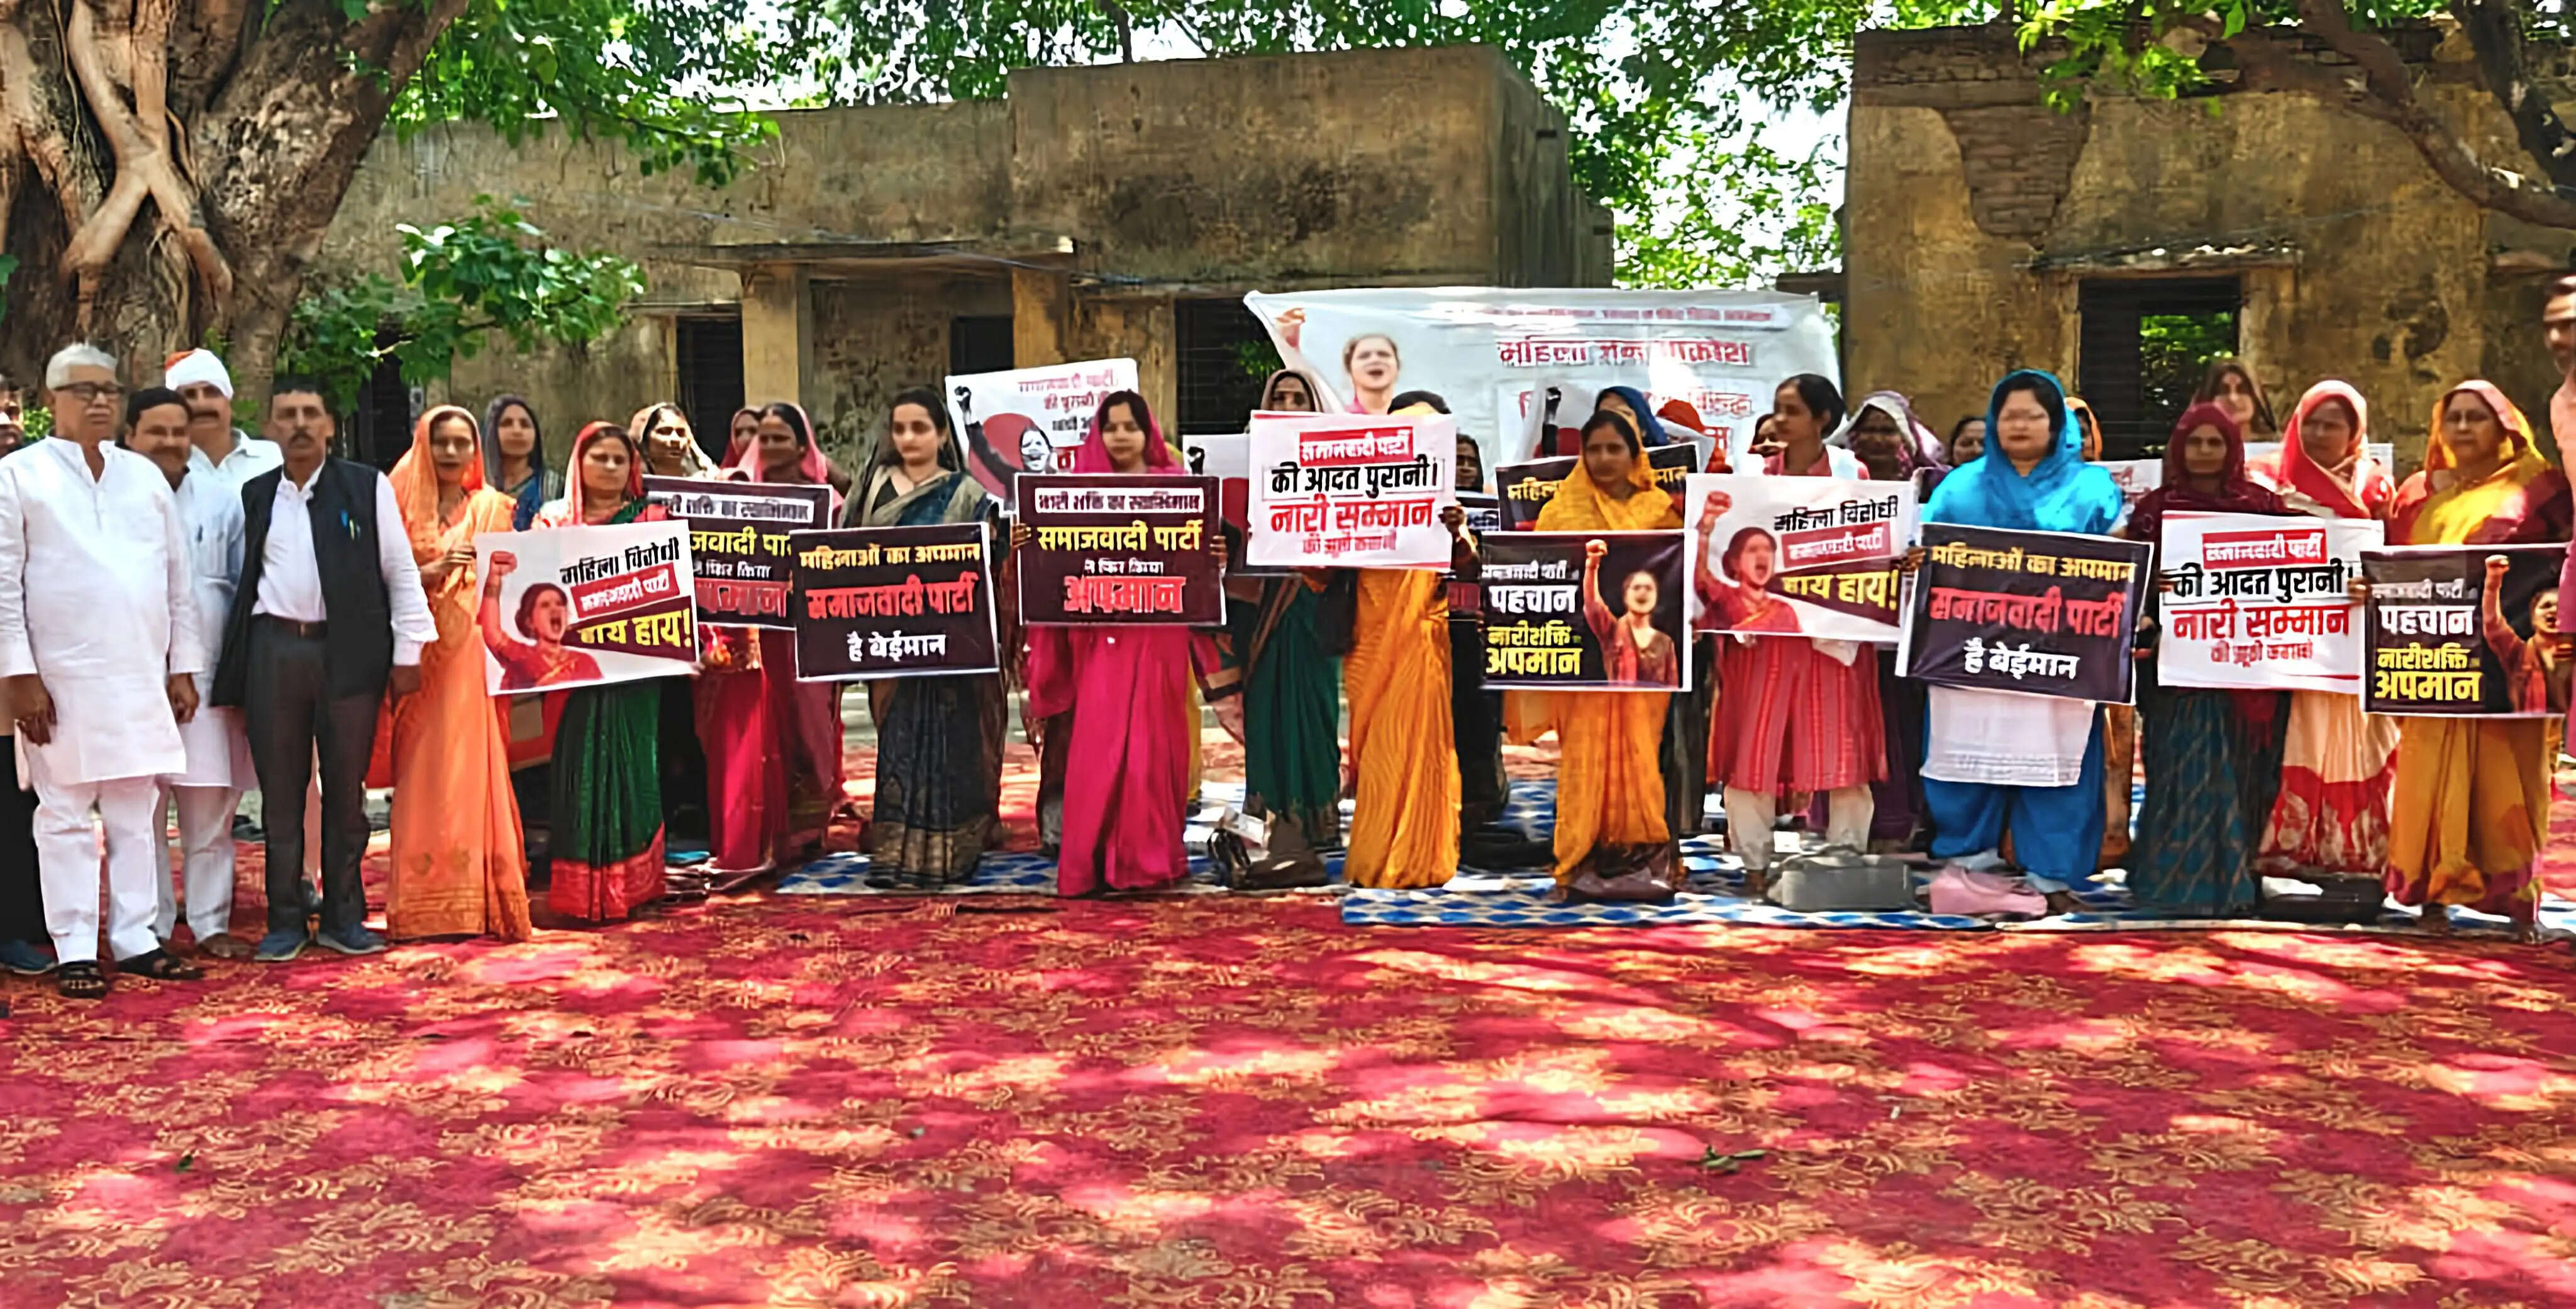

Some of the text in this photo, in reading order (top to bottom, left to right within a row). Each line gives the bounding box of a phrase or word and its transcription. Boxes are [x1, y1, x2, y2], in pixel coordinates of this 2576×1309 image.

[1271, 461, 1301, 493] की
[1305, 466, 1361, 493] आदत
[1269, 493, 1330, 533] नारी
[1335, 498, 1435, 533] सम्मान
[1774, 506, 1836, 532] महिला
[689, 526, 757, 555] जवादी
[1036, 520, 1204, 550] समाजवादी पार्टी
[883, 547, 911, 564] का
[914, 543, 980, 563] अपमान
[1931, 542, 2137, 583] महिलाओं का अपमान
[805, 571, 979, 620] समाजवादी पार्टी
[1063, 574, 1187, 614] अपमान
[1836, 569, 1899, 611] हाय!
[2170, 562, 2204, 598] की
[2210, 569, 2273, 596] आदत
[1489, 585, 1579, 613] पहचान
[1930, 585, 2127, 639] समाजवादी पार्टी
[632, 608, 691, 647] हाय!
[2170, 598, 2351, 640] नारी सम्मान
[2378, 605, 2476, 635] पहचान
[847, 630, 947, 662] है बेईमान
[1485, 648, 1583, 675] अपमान
[1963, 637, 2080, 680] है बेईमान
[2377, 642, 2471, 669] नारीशक्ति
[2374, 669, 2484, 701] अपमान
